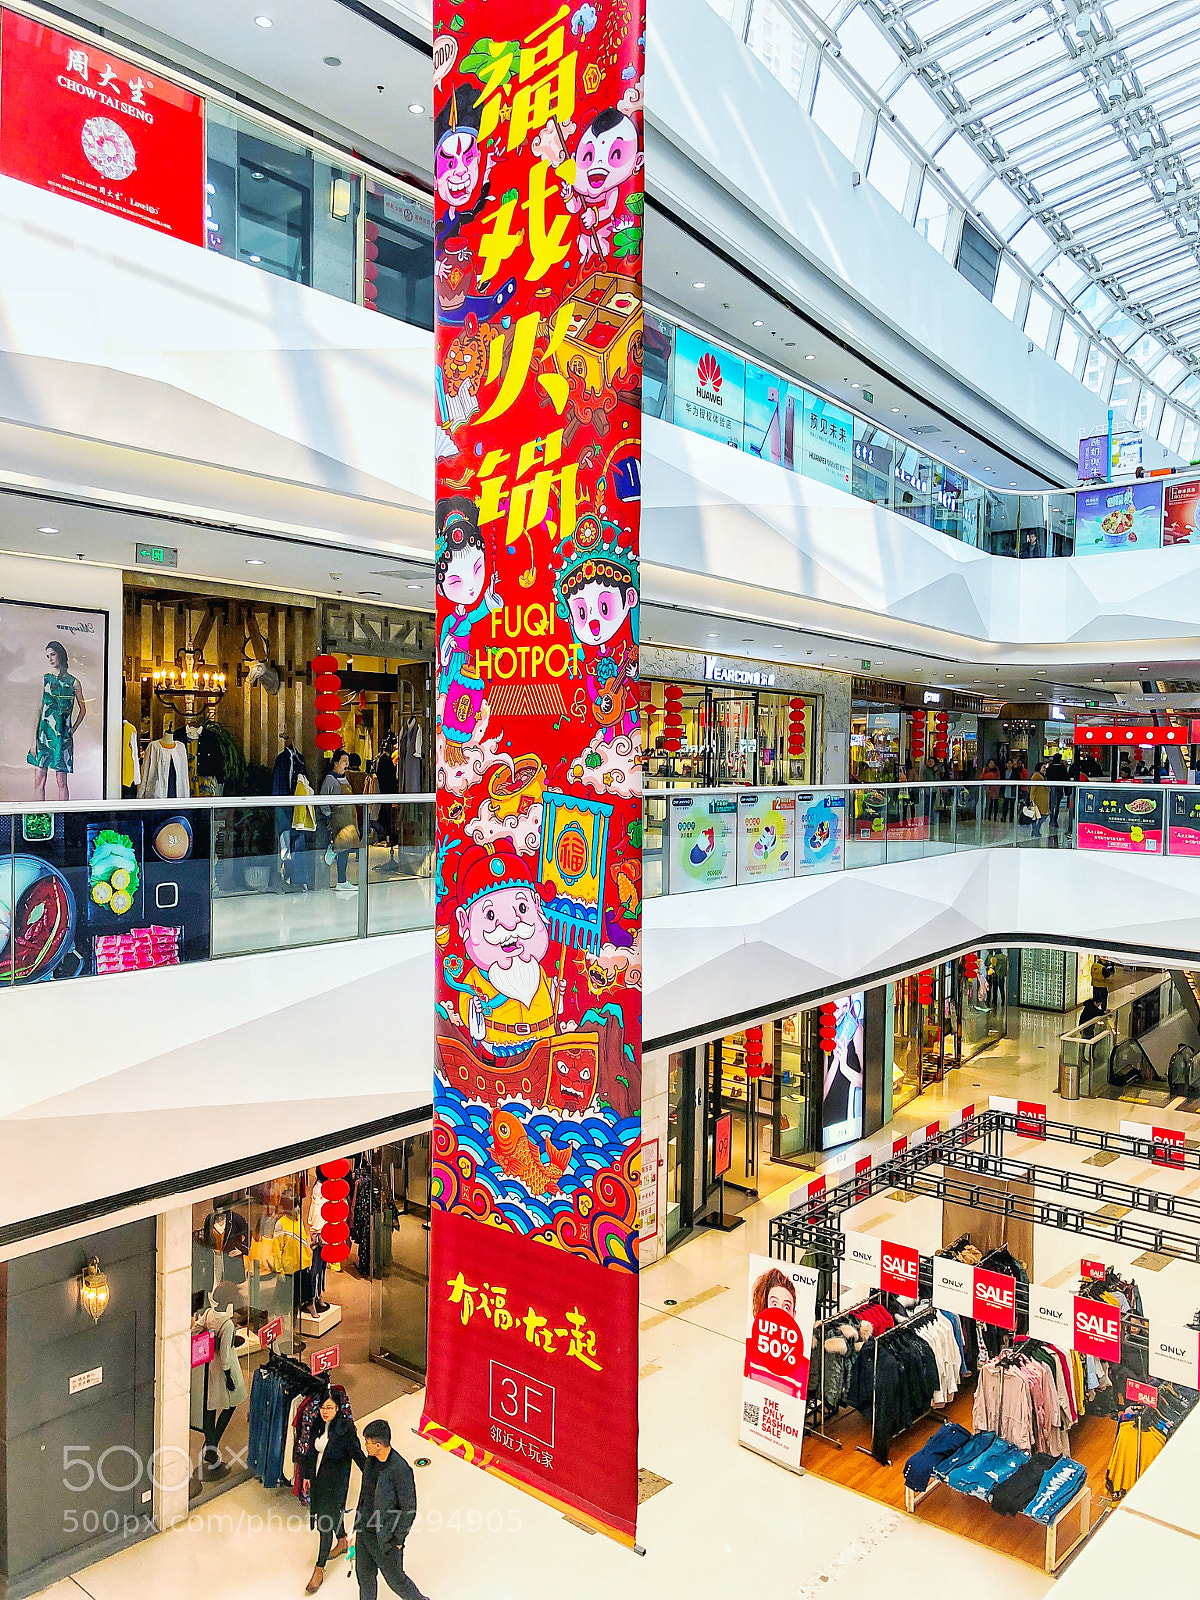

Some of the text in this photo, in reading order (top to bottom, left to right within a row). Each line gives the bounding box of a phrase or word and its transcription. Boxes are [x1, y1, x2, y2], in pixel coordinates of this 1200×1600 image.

[57, 75, 154, 124] CHOW TAI SENG
[696, 386, 723, 407] HUAWEI
[810, 412, 847, 443] 预见未来
[491, 602, 556, 640] FUQI
[474, 643, 584, 682] HOTPOT
[704, 656, 754, 684] YEARCON
[559, 837, 585, 873] 福
[852, 1250, 872, 1262] ONLY
[882, 1254, 917, 1279] SALE
[792, 1273, 817, 1286] ONLY
[941, 1277, 964, 1289] ONLY
[975, 1282, 1013, 1307] SALE
[1039, 1306, 1063, 1319] ONLY
[1076, 1311, 1118, 1339] SALE
[758, 1319, 798, 1344] UP TO
[757, 1334, 796, 1365] 50%
[1160, 1343, 1187, 1357] ONLY
[500, 1377, 543, 1424] 3F
[763, 1396, 780, 1412] THE
[762, 1406, 785, 1422] ONLY
[762, 1413, 799, 1439] FASHION
[761, 1422, 782, 1440] SALE
[489, 1424, 555, 1470] 邻近大玩家
